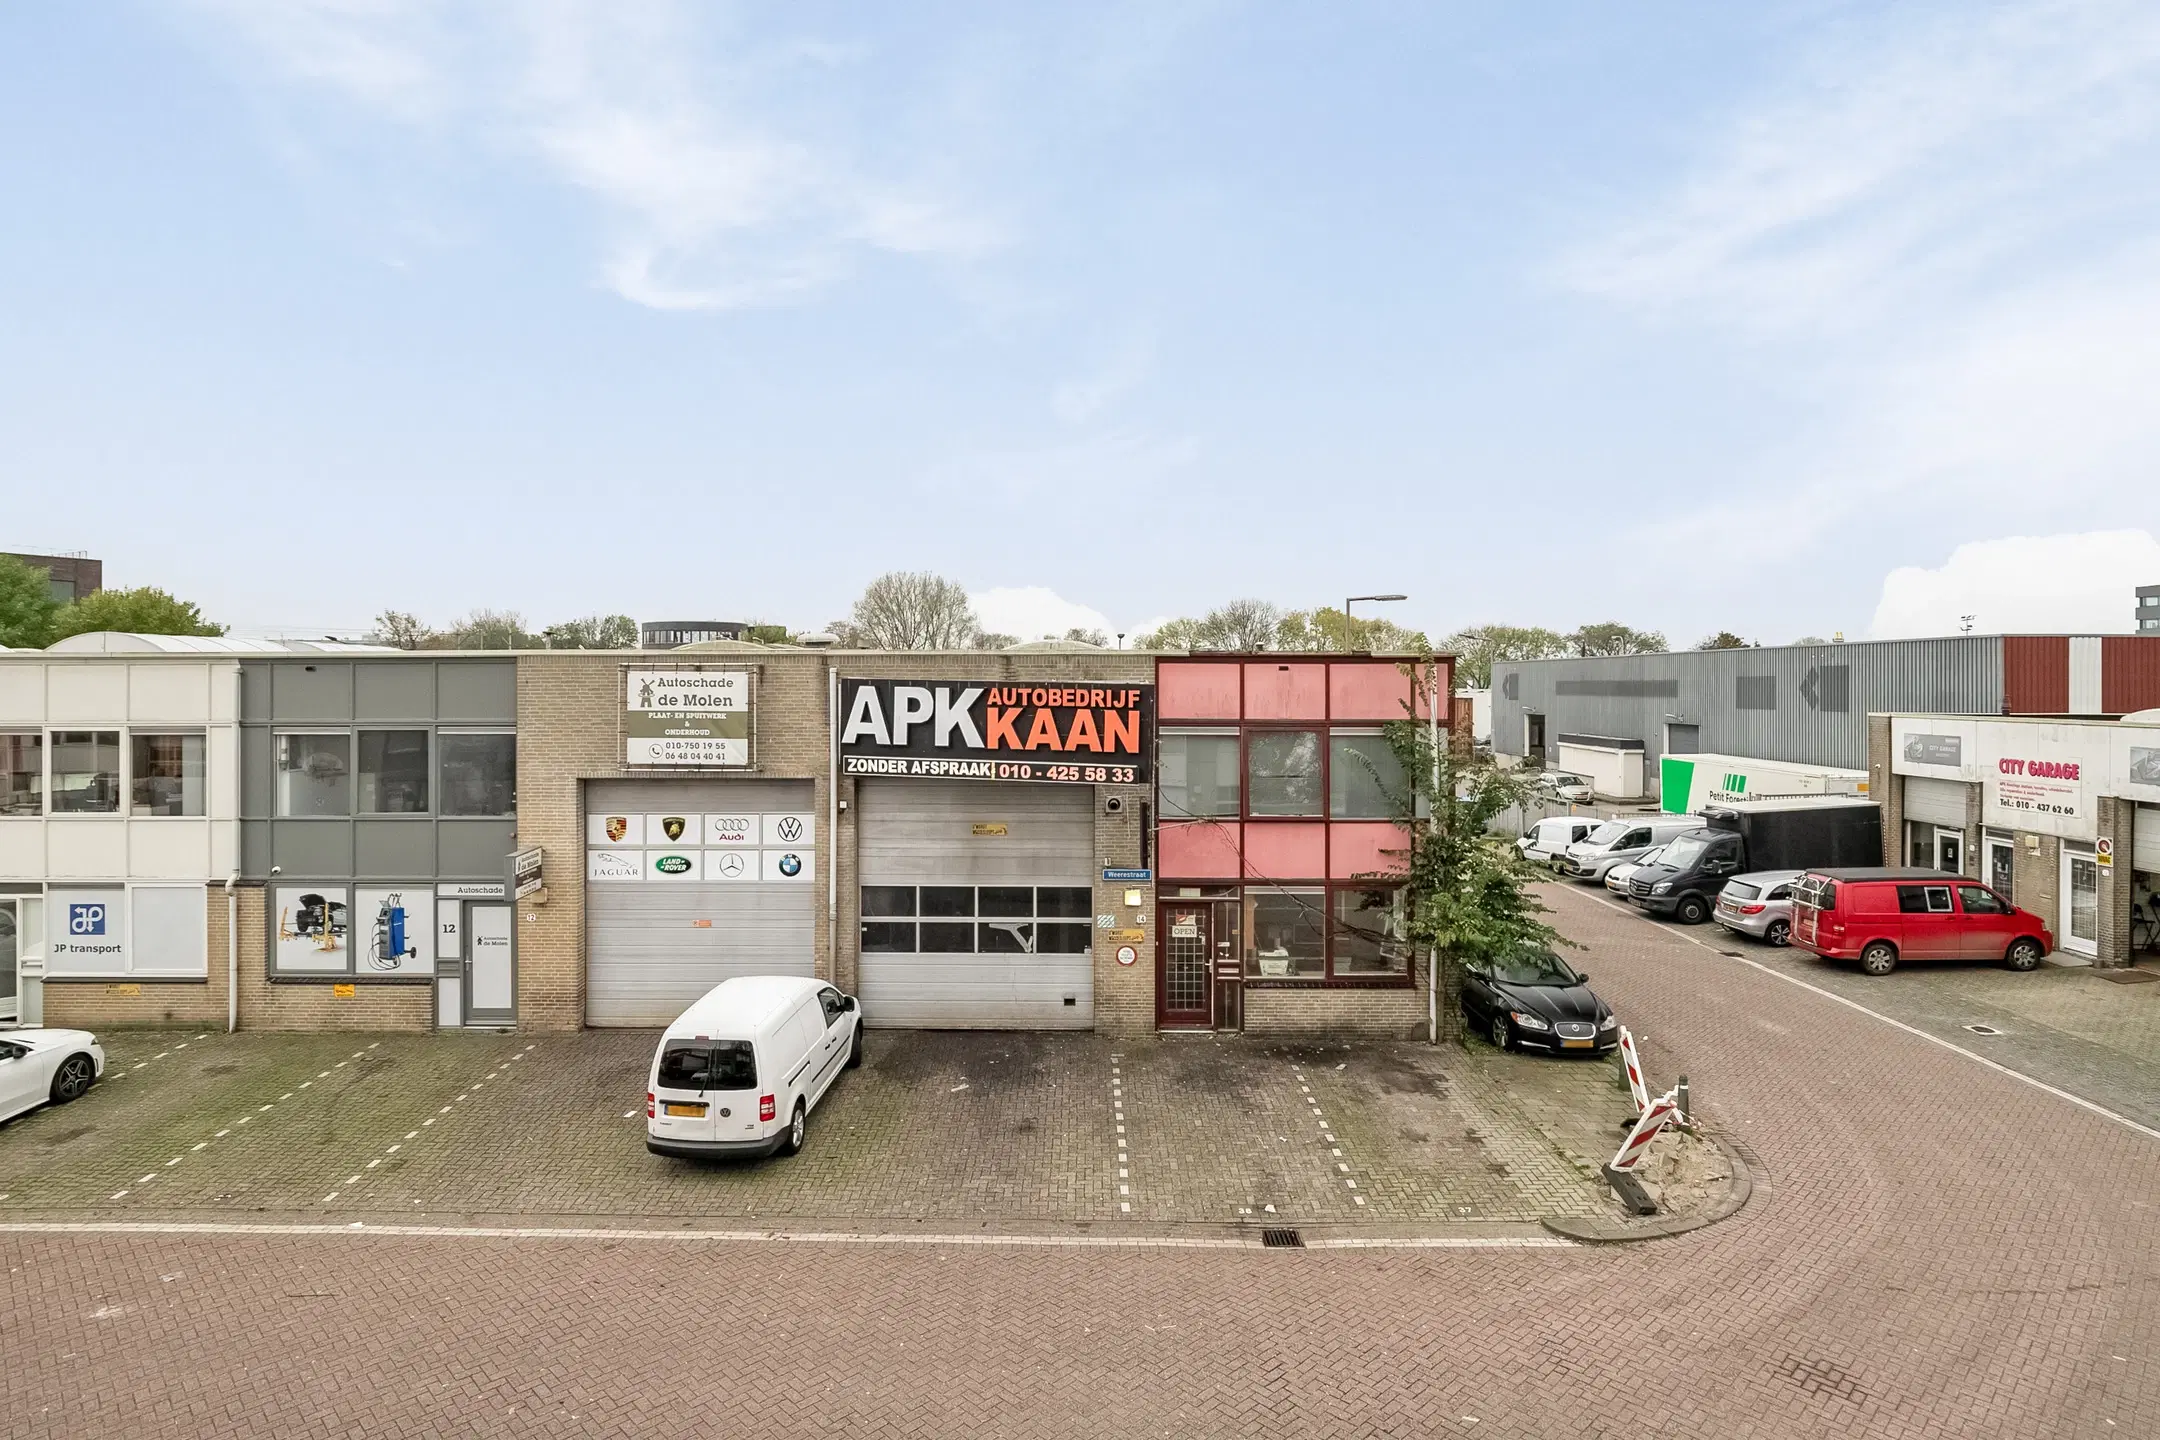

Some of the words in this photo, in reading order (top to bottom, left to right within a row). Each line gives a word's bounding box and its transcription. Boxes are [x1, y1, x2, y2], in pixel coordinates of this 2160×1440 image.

[657, 677, 734, 688] Autoschade
[658, 694, 678, 706] de
[683, 694, 733, 707] Molen
[987, 687, 1141, 708] AUTOBEDRIJF
[841, 685, 985, 748] APK
[986, 707, 1140, 754] KAAN
[665, 742, 700, 750] 010-750
[703, 742, 713, 750] 19
[715, 742, 726, 750] 55
[847, 759, 908, 774] ZONDER
[911, 760, 991, 776] AFSPRAAK
[1000, 764, 1031, 779] 010
[1046, 765, 1079, 781] 425
[1085, 767, 1106, 782] 58
[1112, 768, 1134, 782] 33
[1999, 758, 2025, 775] CITY
[2028, 760, 2080, 781] GARAGE
[1709, 790, 1725, 802] Petit
[2000, 798, 2014, 807] Tel.:
[2016, 800, 2029, 809] 010
[2036, 803, 2050, 812] 437
[2052, 805, 2062, 814] 62
[2064, 807, 2074, 815] 60
[719, 833, 744, 841] Audi
[594, 868, 638, 877] JAGUAR
[457, 886, 503, 894] Autoschade
[442, 924, 456, 934] 12
[54, 944, 67, 953] JP
[70, 944, 122, 955] transport
